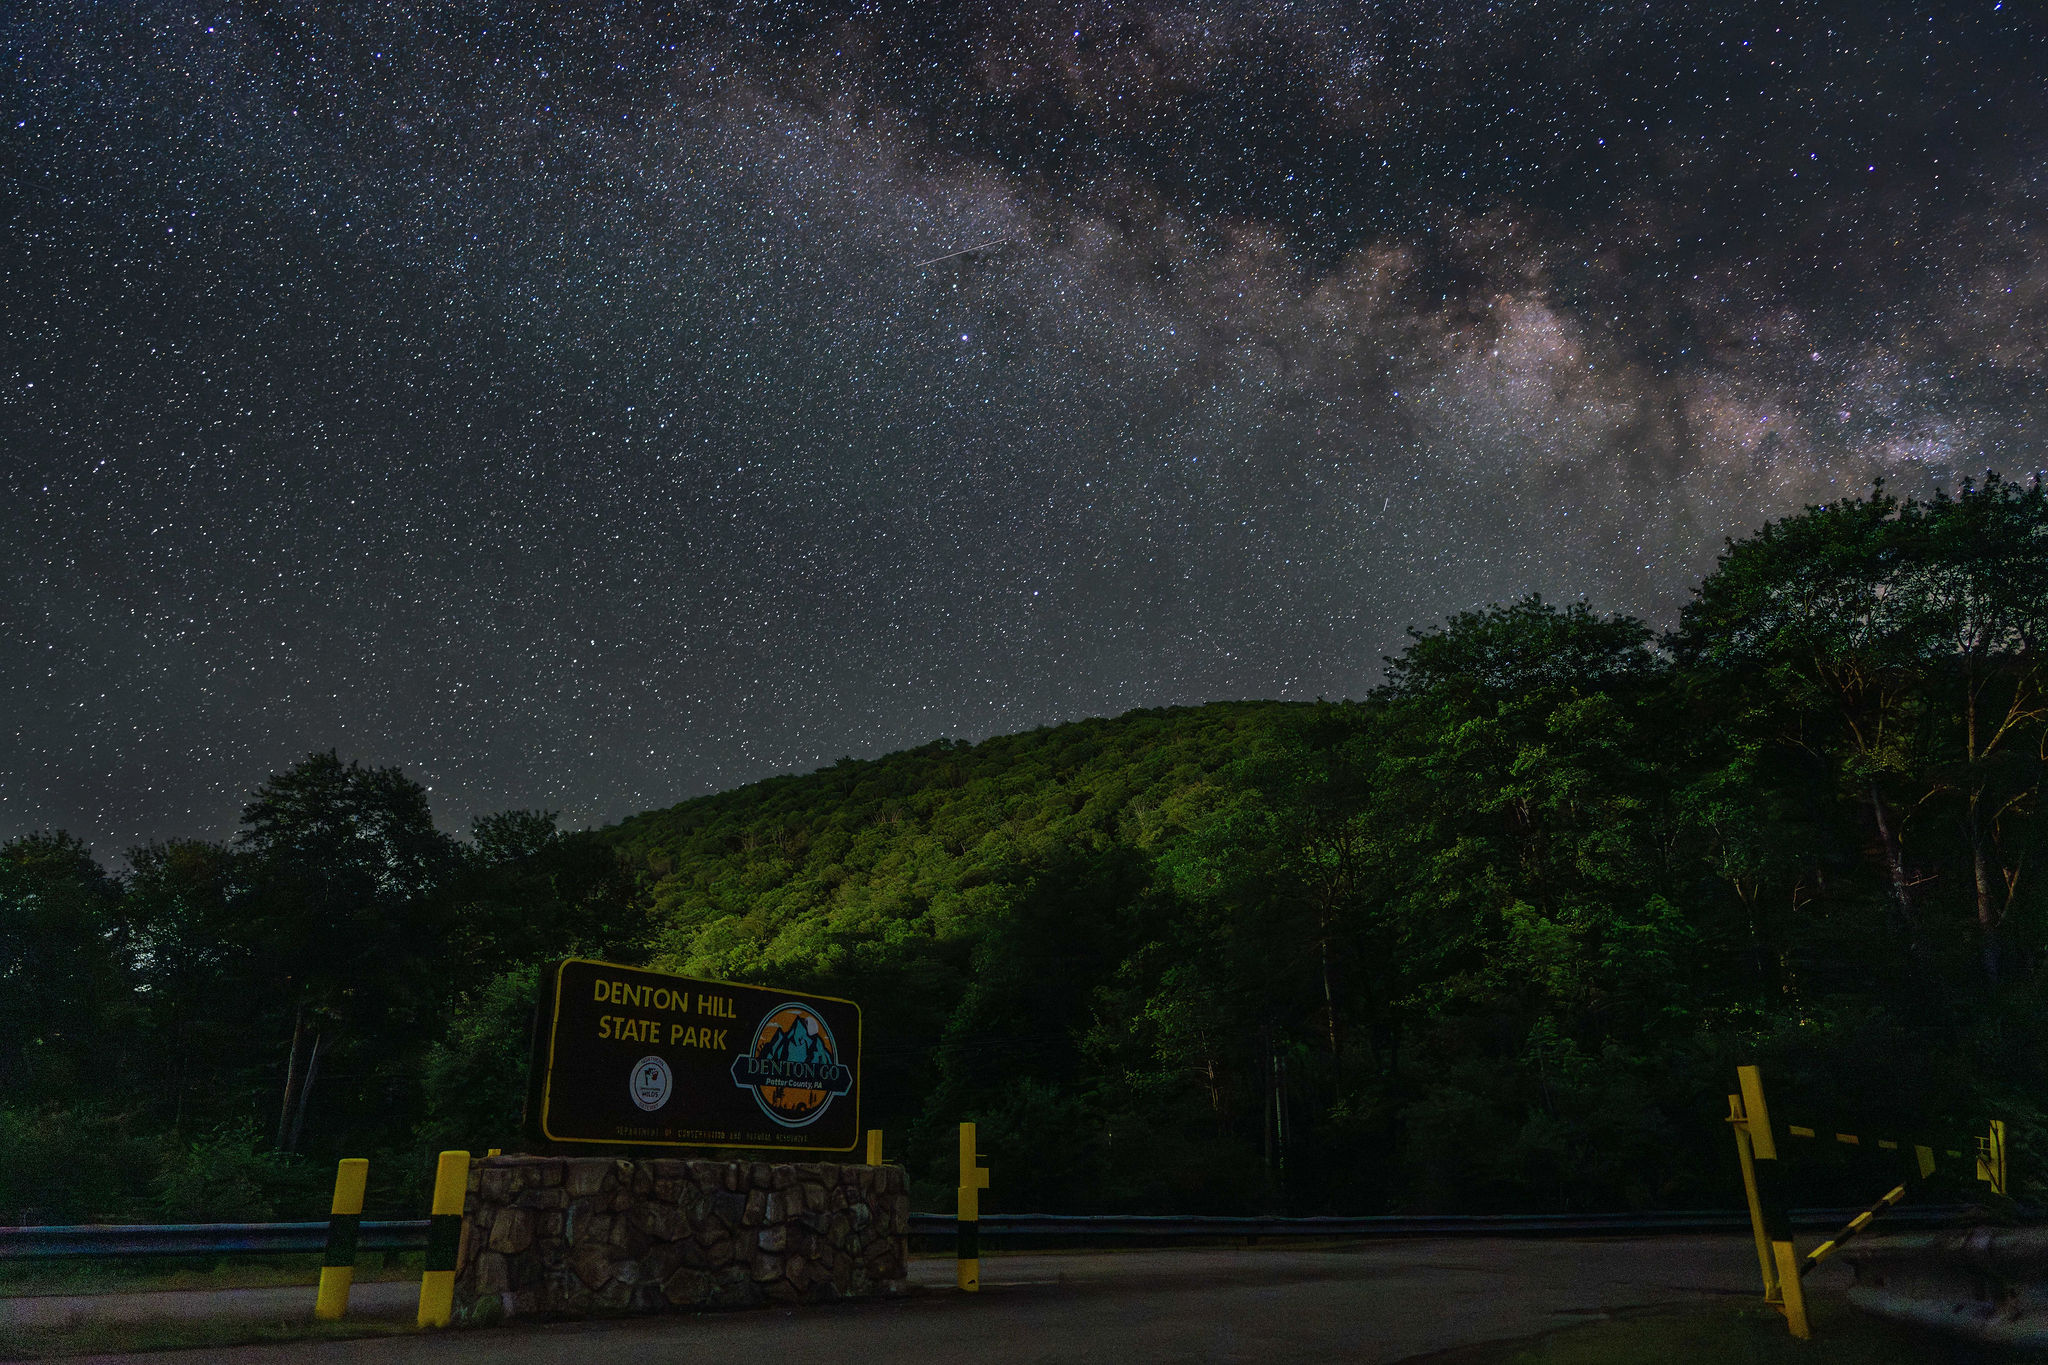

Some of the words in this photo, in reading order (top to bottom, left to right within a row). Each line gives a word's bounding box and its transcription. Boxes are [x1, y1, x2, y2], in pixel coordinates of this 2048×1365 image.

[594, 979, 689, 1013] DENTON
[697, 994, 737, 1019] HILL
[598, 1015, 661, 1043] STATE
[671, 1024, 728, 1050] PARK
[747, 1057, 816, 1079] DENTON
[765, 1077, 788, 1087] Potter
[788, 1079, 813, 1090] County,
[814, 1081, 823, 1089] PA
